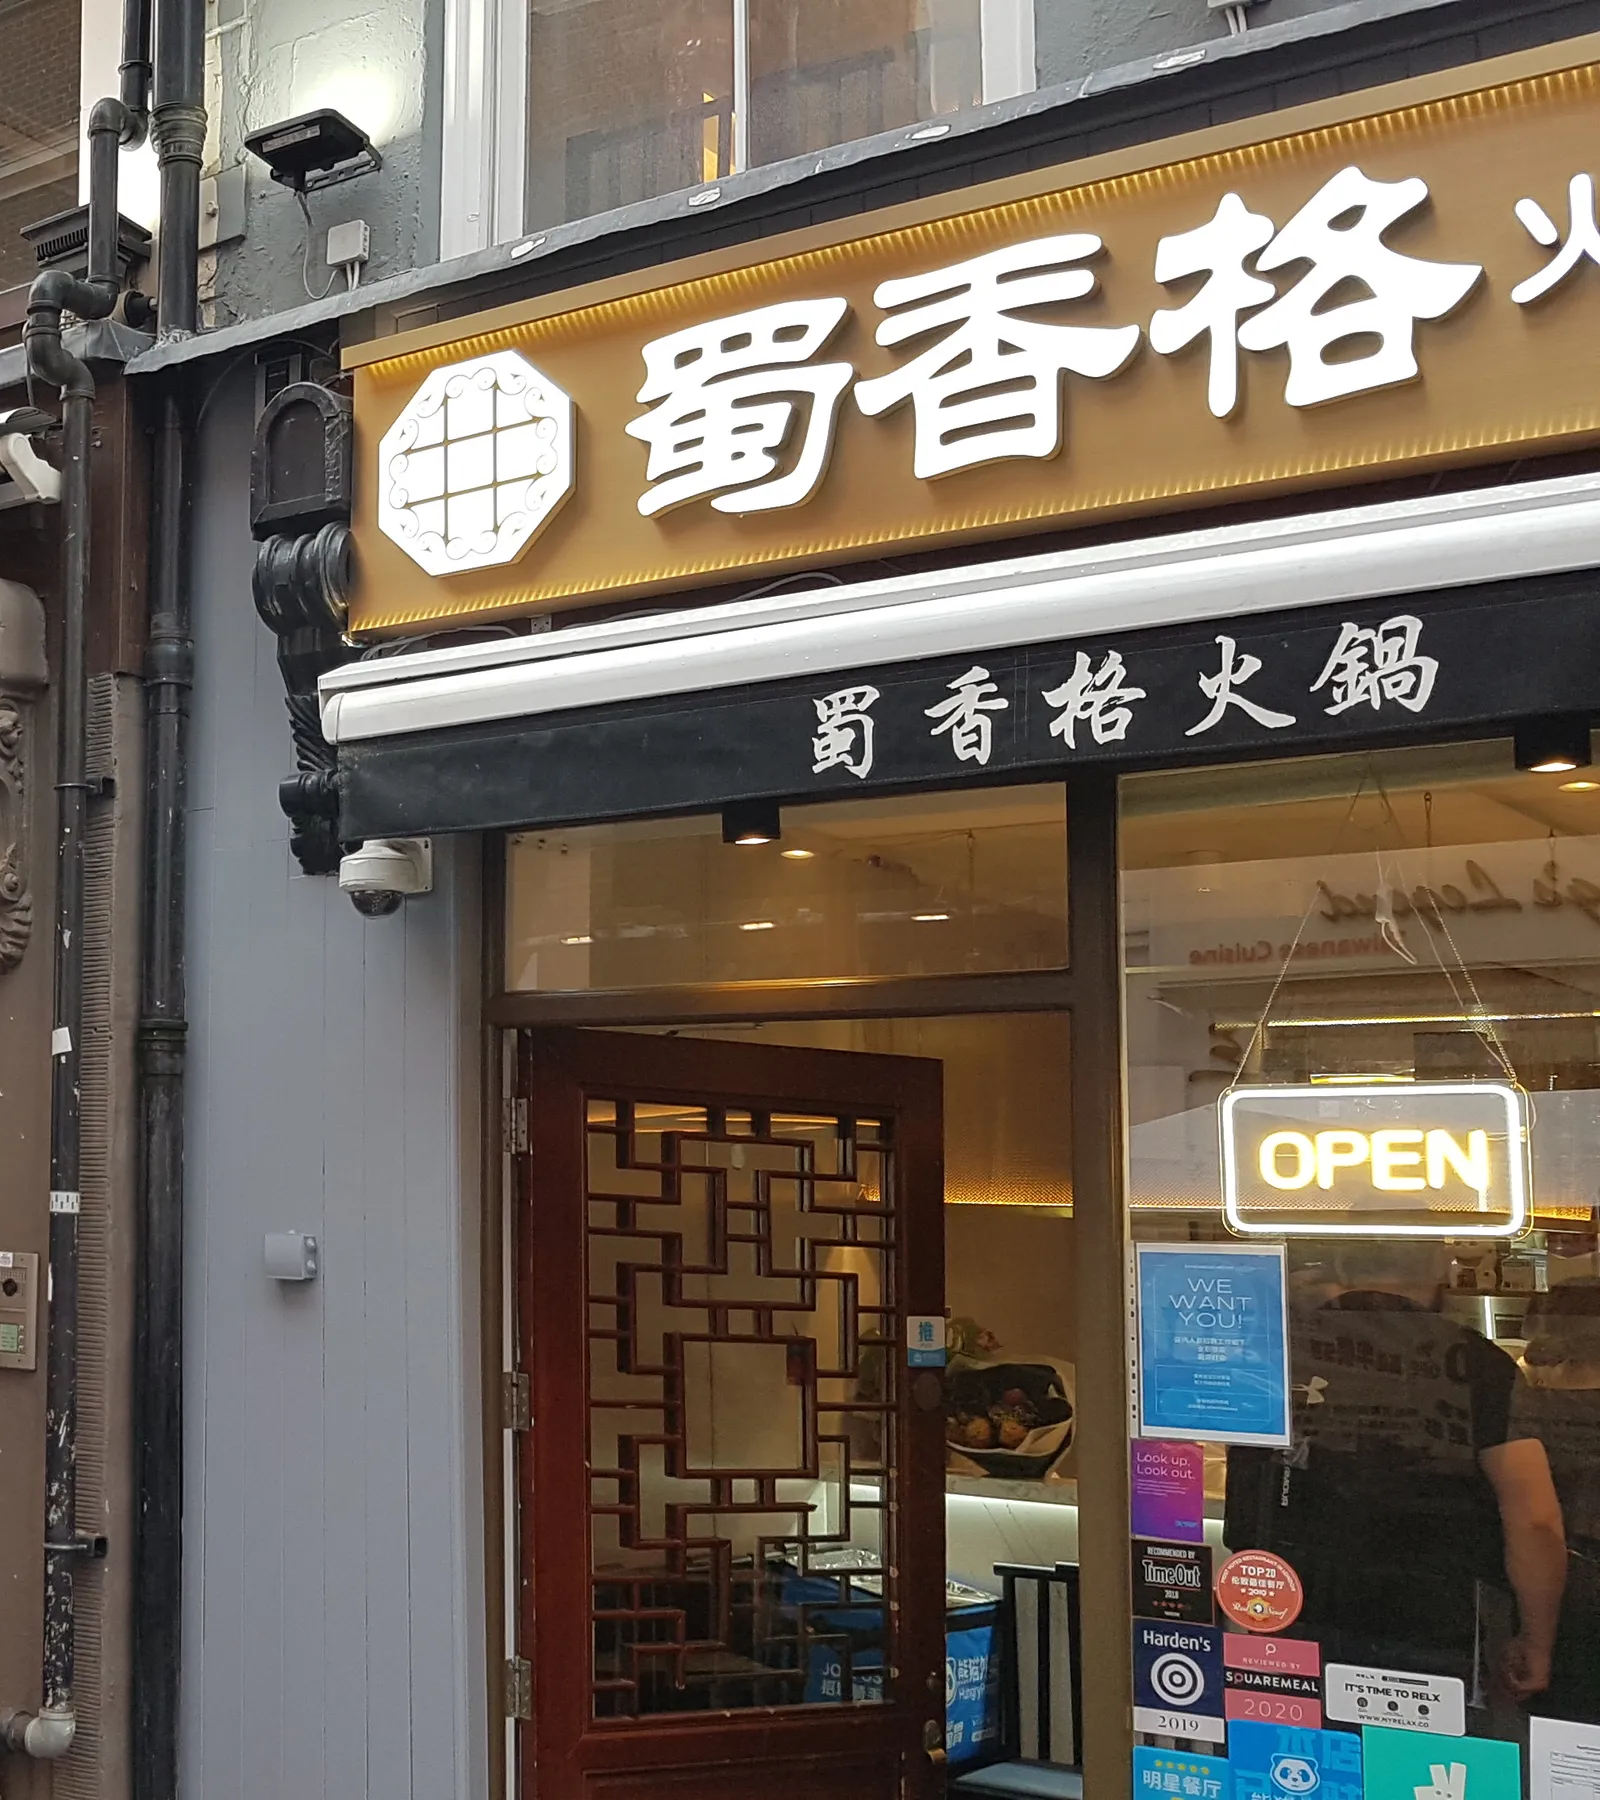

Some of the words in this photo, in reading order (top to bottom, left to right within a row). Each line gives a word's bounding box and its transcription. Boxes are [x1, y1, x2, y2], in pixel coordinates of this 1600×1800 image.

[809, 613, 1441, 779] 蜀香格火鍋
[1257, 1127, 1492, 1192] OPEN
[1187, 1278, 1233, 1294] WE
[1169, 1294, 1253, 1312] WANT
[1178, 1311, 1243, 1329] YOU!
[1136, 1451, 1168, 1464] Look
[1136, 1463, 1168, 1477] Look
[1171, 1468, 1196, 1480] out.
[1146, 1546, 1187, 1558] RECOMMENDED
[1187, 1550, 1196, 1560] BY
[1240, 1564, 1265, 1577] TOP
[1265, 1568, 1276, 1578] 20
[1142, 1629, 1211, 1652] Harden's
[1241, 1656, 1287, 1669] REVIEWED
[1290, 1662, 1301, 1670] BY
[1225, 1670, 1319, 1693] SQUAREMEAL
[1344, 1682, 1365, 1694] IT'S
[1365, 1685, 1392, 1697] TIME
[1393, 1688, 1410, 1699] TO
[1411, 1690, 1442, 1703] RELX
[1243, 1698, 1303, 1722] 2020
[1157, 1714, 1200, 1733] 2019
[1142, 1768, 1223, 1799] 明星餐厅
